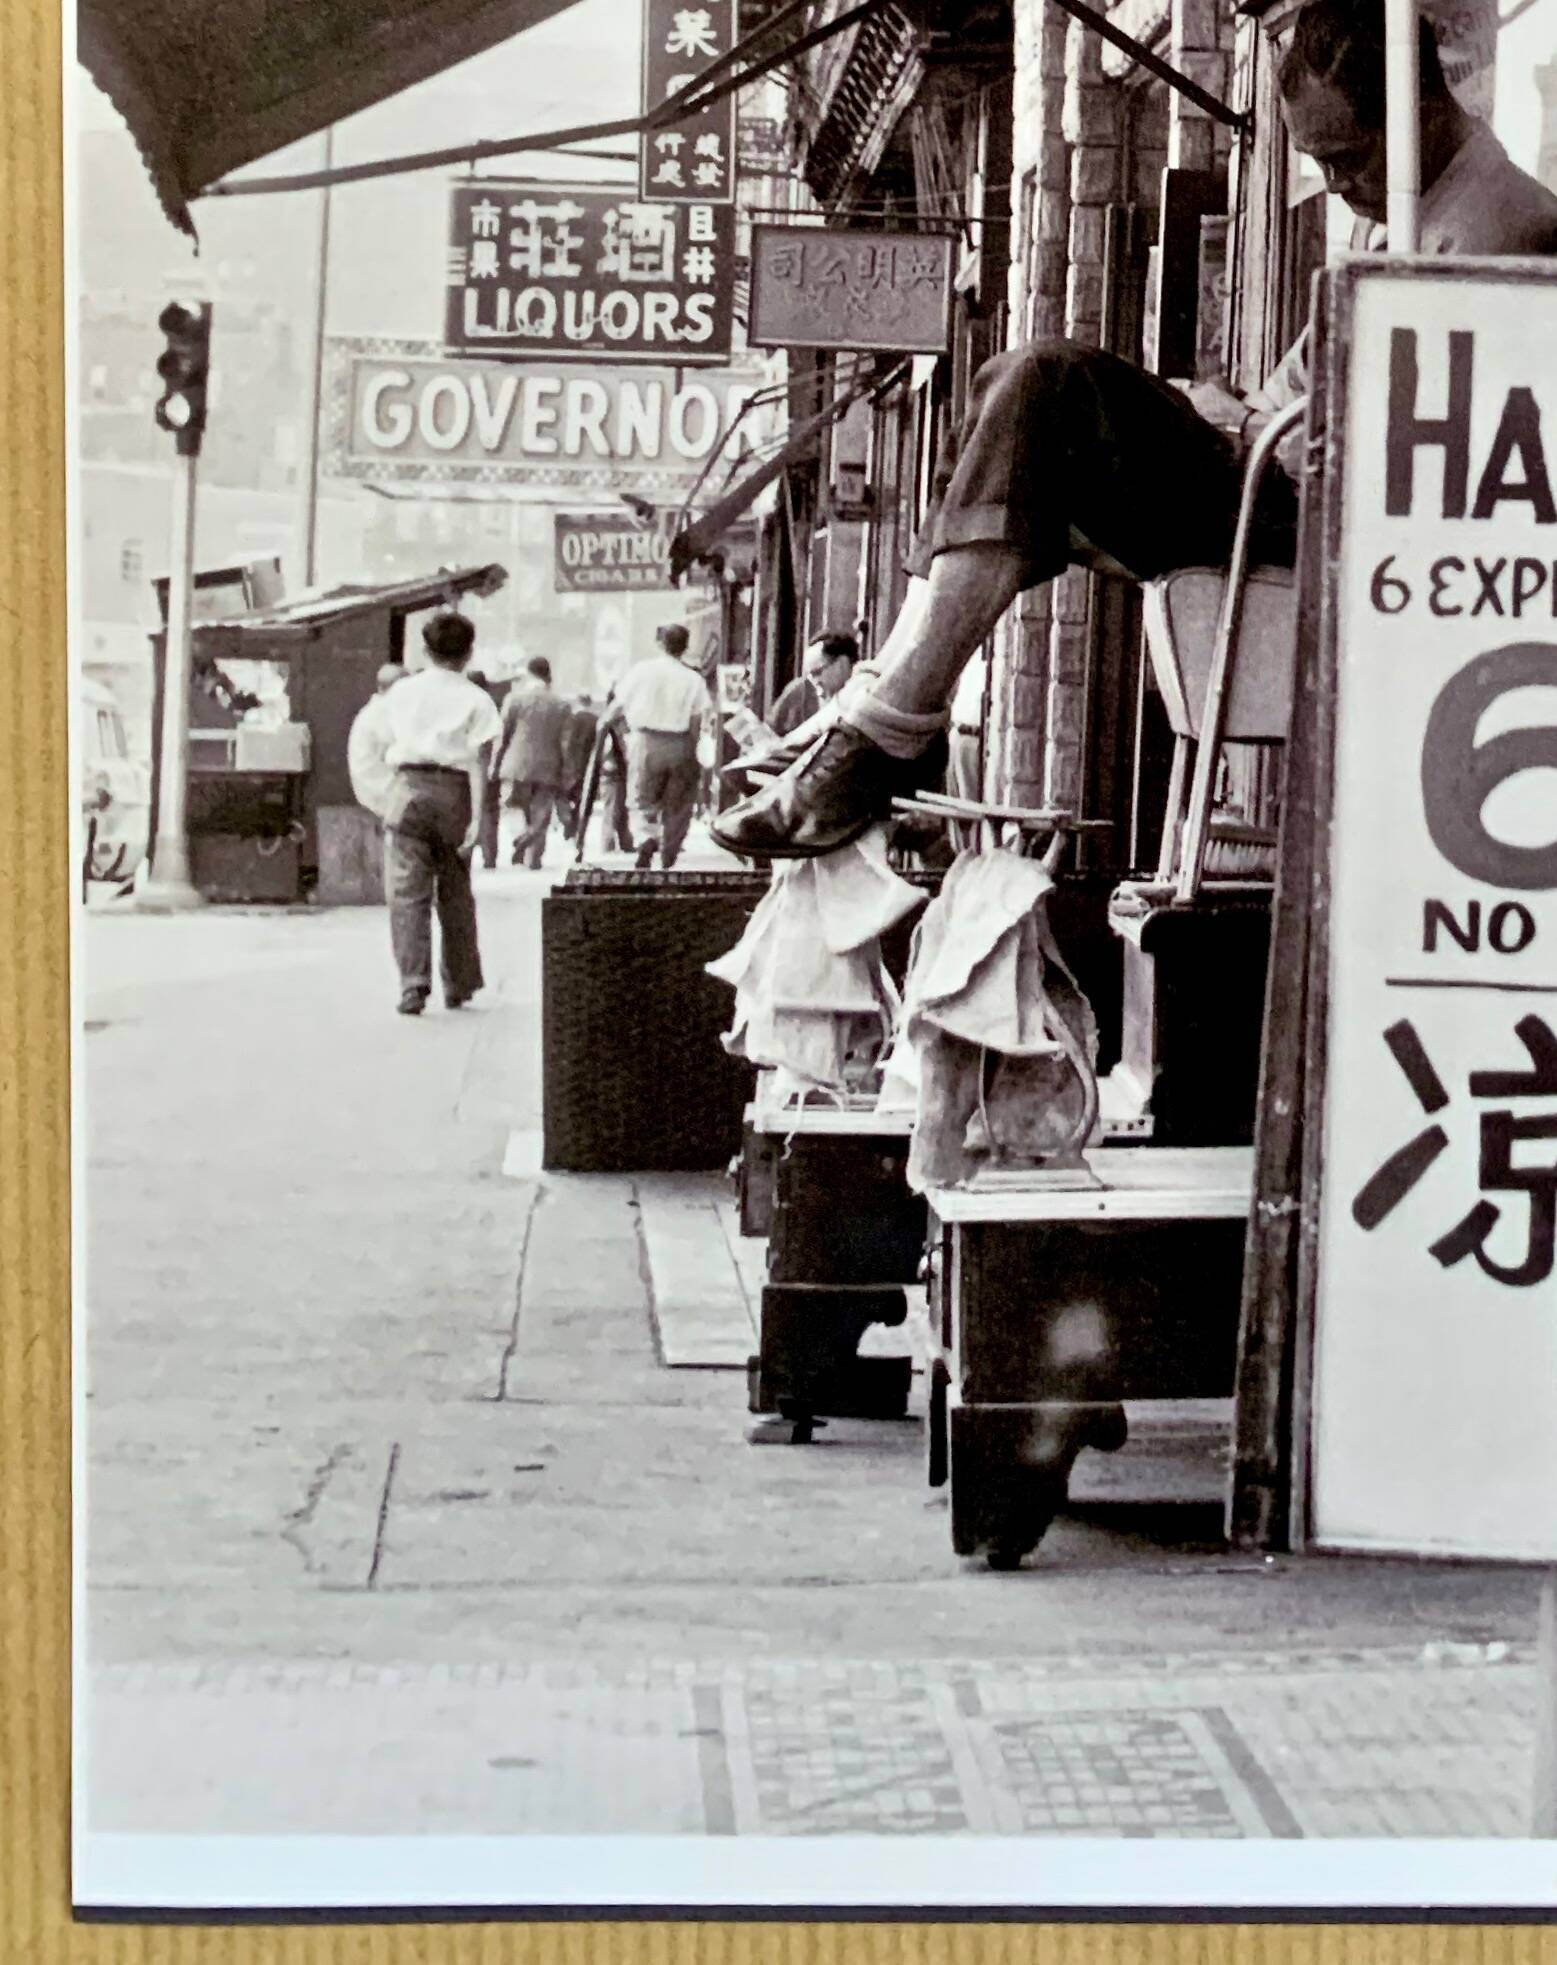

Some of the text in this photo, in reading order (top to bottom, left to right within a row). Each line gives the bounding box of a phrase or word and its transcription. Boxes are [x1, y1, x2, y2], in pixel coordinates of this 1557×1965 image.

[464, 286, 716, 343] LIQUORS
[1385, 326, 1557, 524] HA
[562, 532, 671, 566] OPTIMO
[1370, 554, 1557, 618] 6 EXP
[1423, 898, 1536, 954] NO
